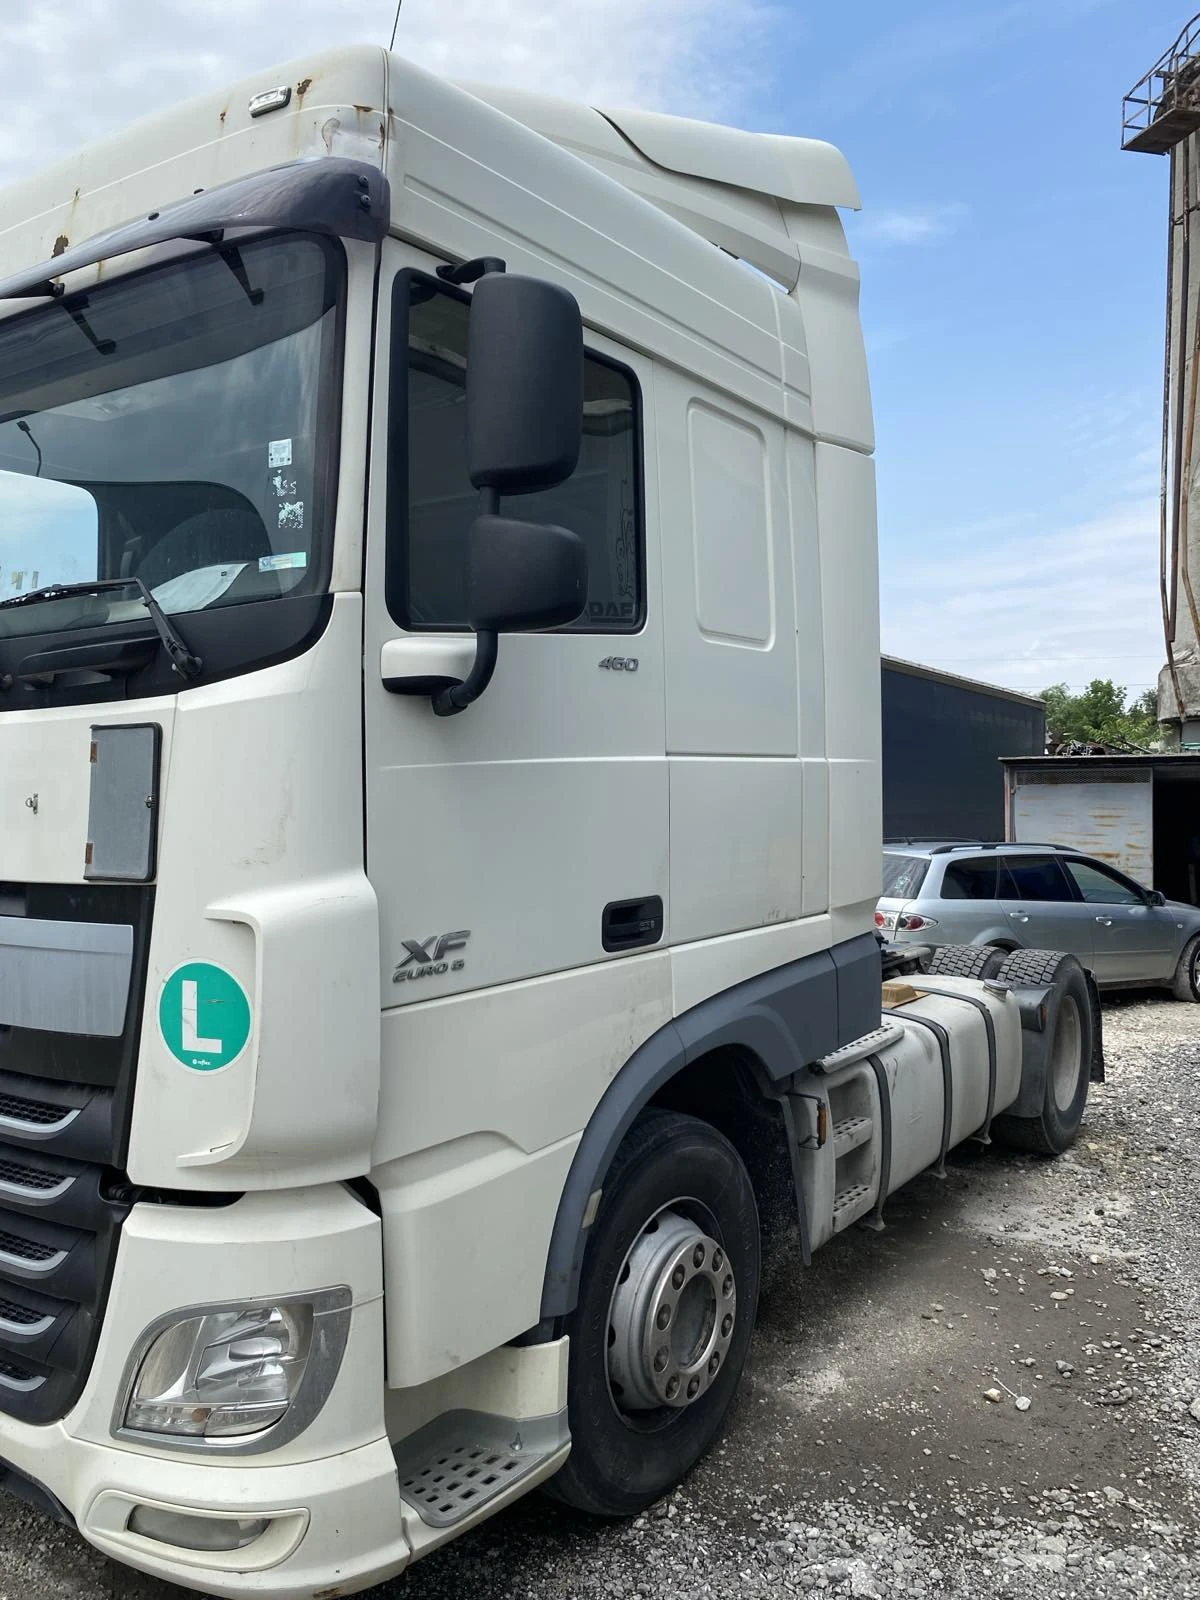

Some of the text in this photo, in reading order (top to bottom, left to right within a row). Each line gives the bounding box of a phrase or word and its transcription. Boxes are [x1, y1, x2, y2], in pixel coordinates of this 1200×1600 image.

[589, 602, 633, 616] DAF
[598, 656, 639, 671] 460
[395, 930, 471, 968] XF
[393, 959, 465, 983] EURO 6
[182, 980, 222, 1053] L
